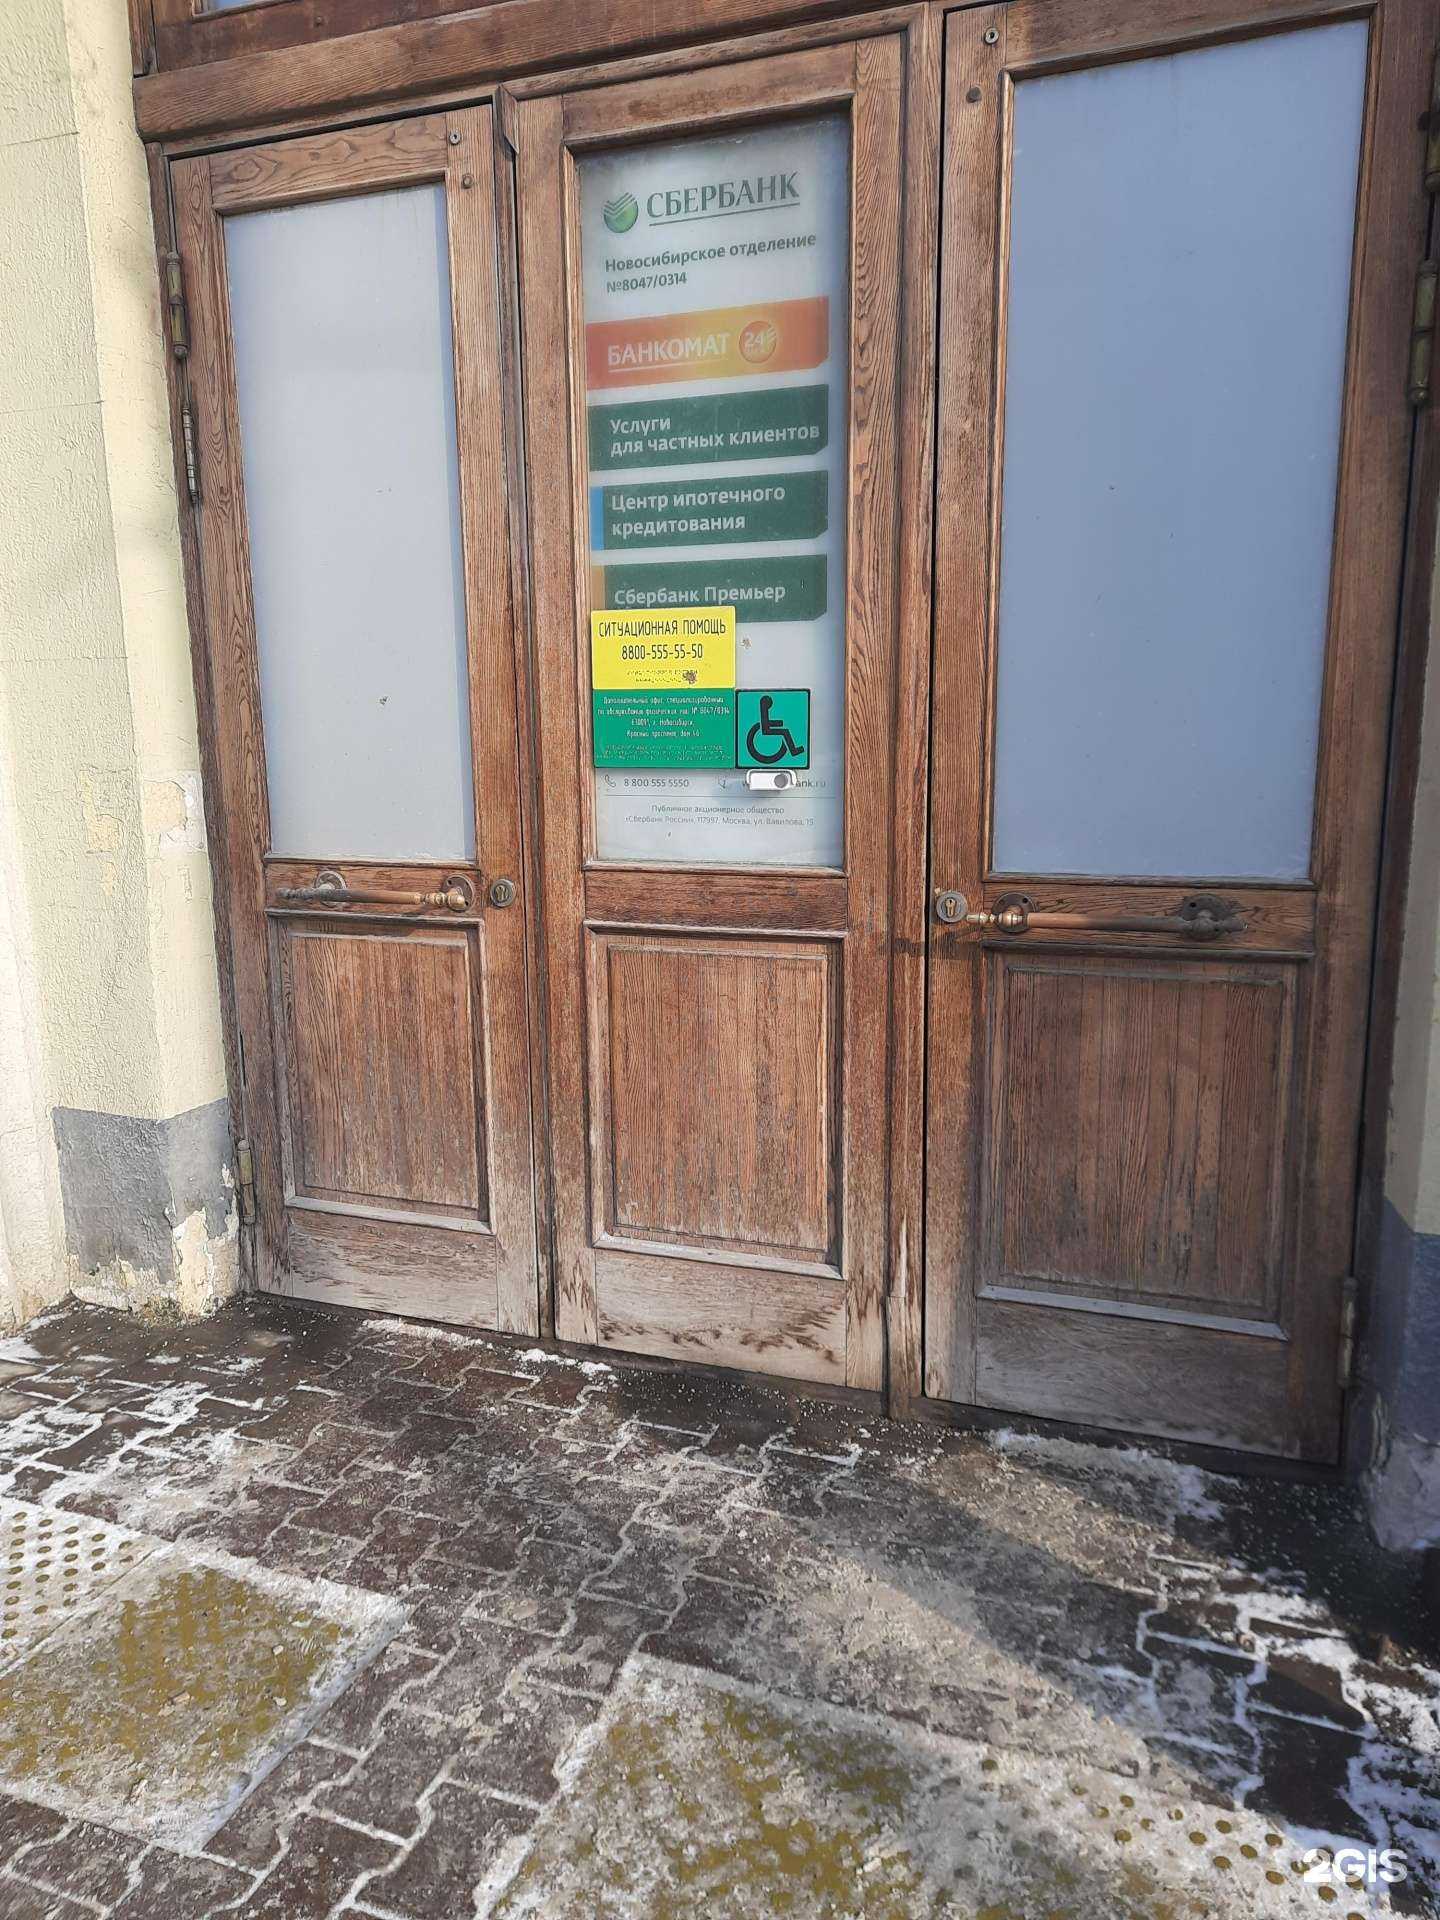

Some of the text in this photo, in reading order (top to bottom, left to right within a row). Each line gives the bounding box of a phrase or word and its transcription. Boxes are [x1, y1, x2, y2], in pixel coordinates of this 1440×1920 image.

[646, 171, 800, 218] СБЕРБАНК
[605, 232, 817, 272] Новосибирское отделение
[605, 271, 688, 294] №8047/0314
[607, 332, 732, 366] БАНКОМАТ
[609, 416, 672, 436] Услуги
[610, 425, 821, 458] для частных клиентов
[611, 486, 786, 512] Центр ипотечного
[611, 515, 746, 539] кредитования
[614, 585, 786, 606] Сбербанк Премьер
[598, 618, 726, 638] СИТУАЦИОННАЯ ПОМОЩЬ
[621, 643, 704, 660] 8800-555-55-50
[623, 778, 690, 788] 8 800 555 5550
[746, 806, 784, 815] общество
